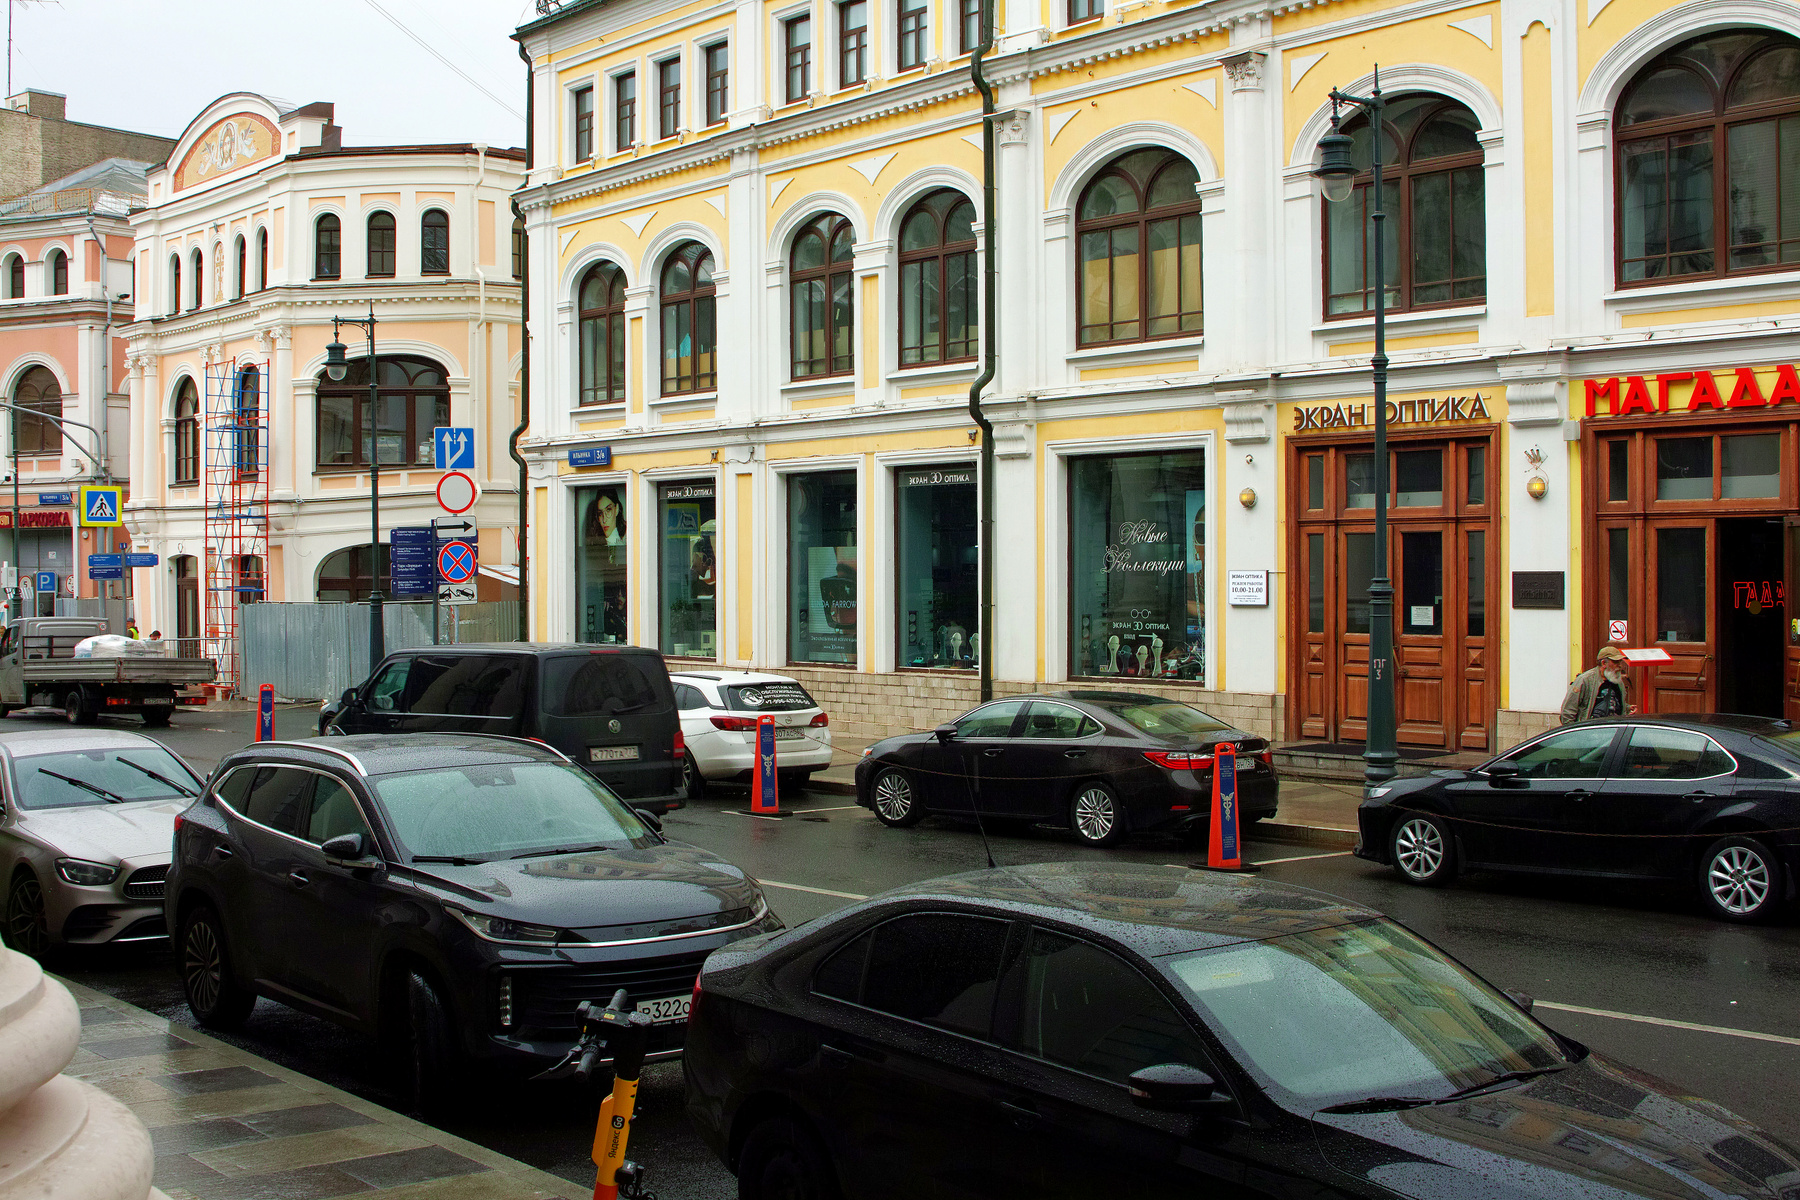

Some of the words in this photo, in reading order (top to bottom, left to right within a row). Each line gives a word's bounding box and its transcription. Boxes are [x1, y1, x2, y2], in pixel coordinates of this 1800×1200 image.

[1584, 364, 1800, 417] МАГАДА
[1294, 402, 1368, 431] ЭКРАН
[1386, 392, 1491, 424] ОПТИКА
[909, 476, 928, 485] ЭКРАН
[944, 474, 970, 483] ОПТИКА
[19, 511, 71, 528] АРКОВКА
[1118, 518, 1169, 545] Новые
[1100, 544, 1186, 577] Коллекции
[1112, 621, 1132, 629] ЭКРАН
[1145, 622, 1170, 630] ОПТИКА
[1373, 658, 1387, 669] ПГ
[1375, 669, 1382, 680] 3
[613, 1116, 624, 1128] Go
[608, 1129, 621, 1159] Яндекс
